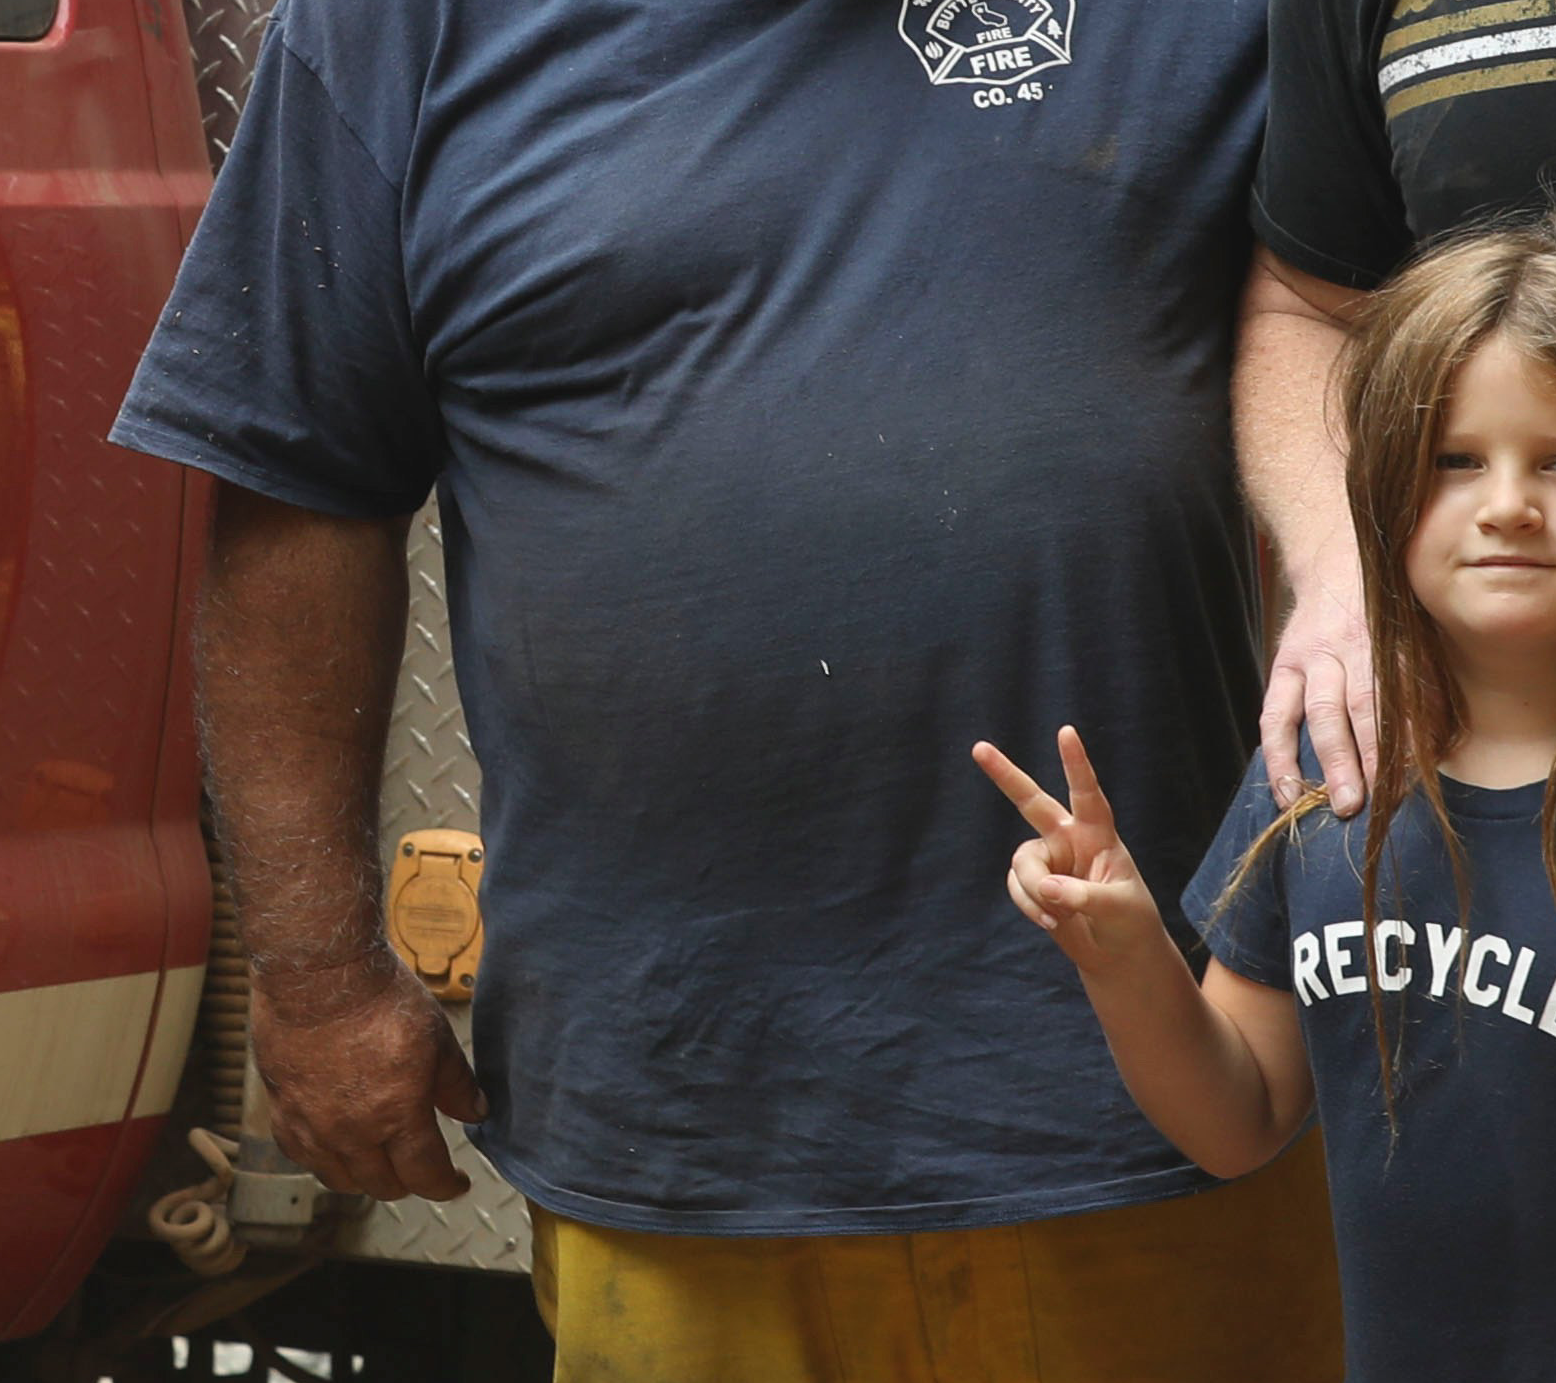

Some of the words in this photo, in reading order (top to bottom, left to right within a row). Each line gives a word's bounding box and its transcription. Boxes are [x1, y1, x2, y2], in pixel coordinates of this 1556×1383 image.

[975, 27, 1013, 44] FIRE
[969, 46, 1034, 76] FIRE
[972, 88, 1013, 109] CO.
[1016, 82, 1044, 101] 45
